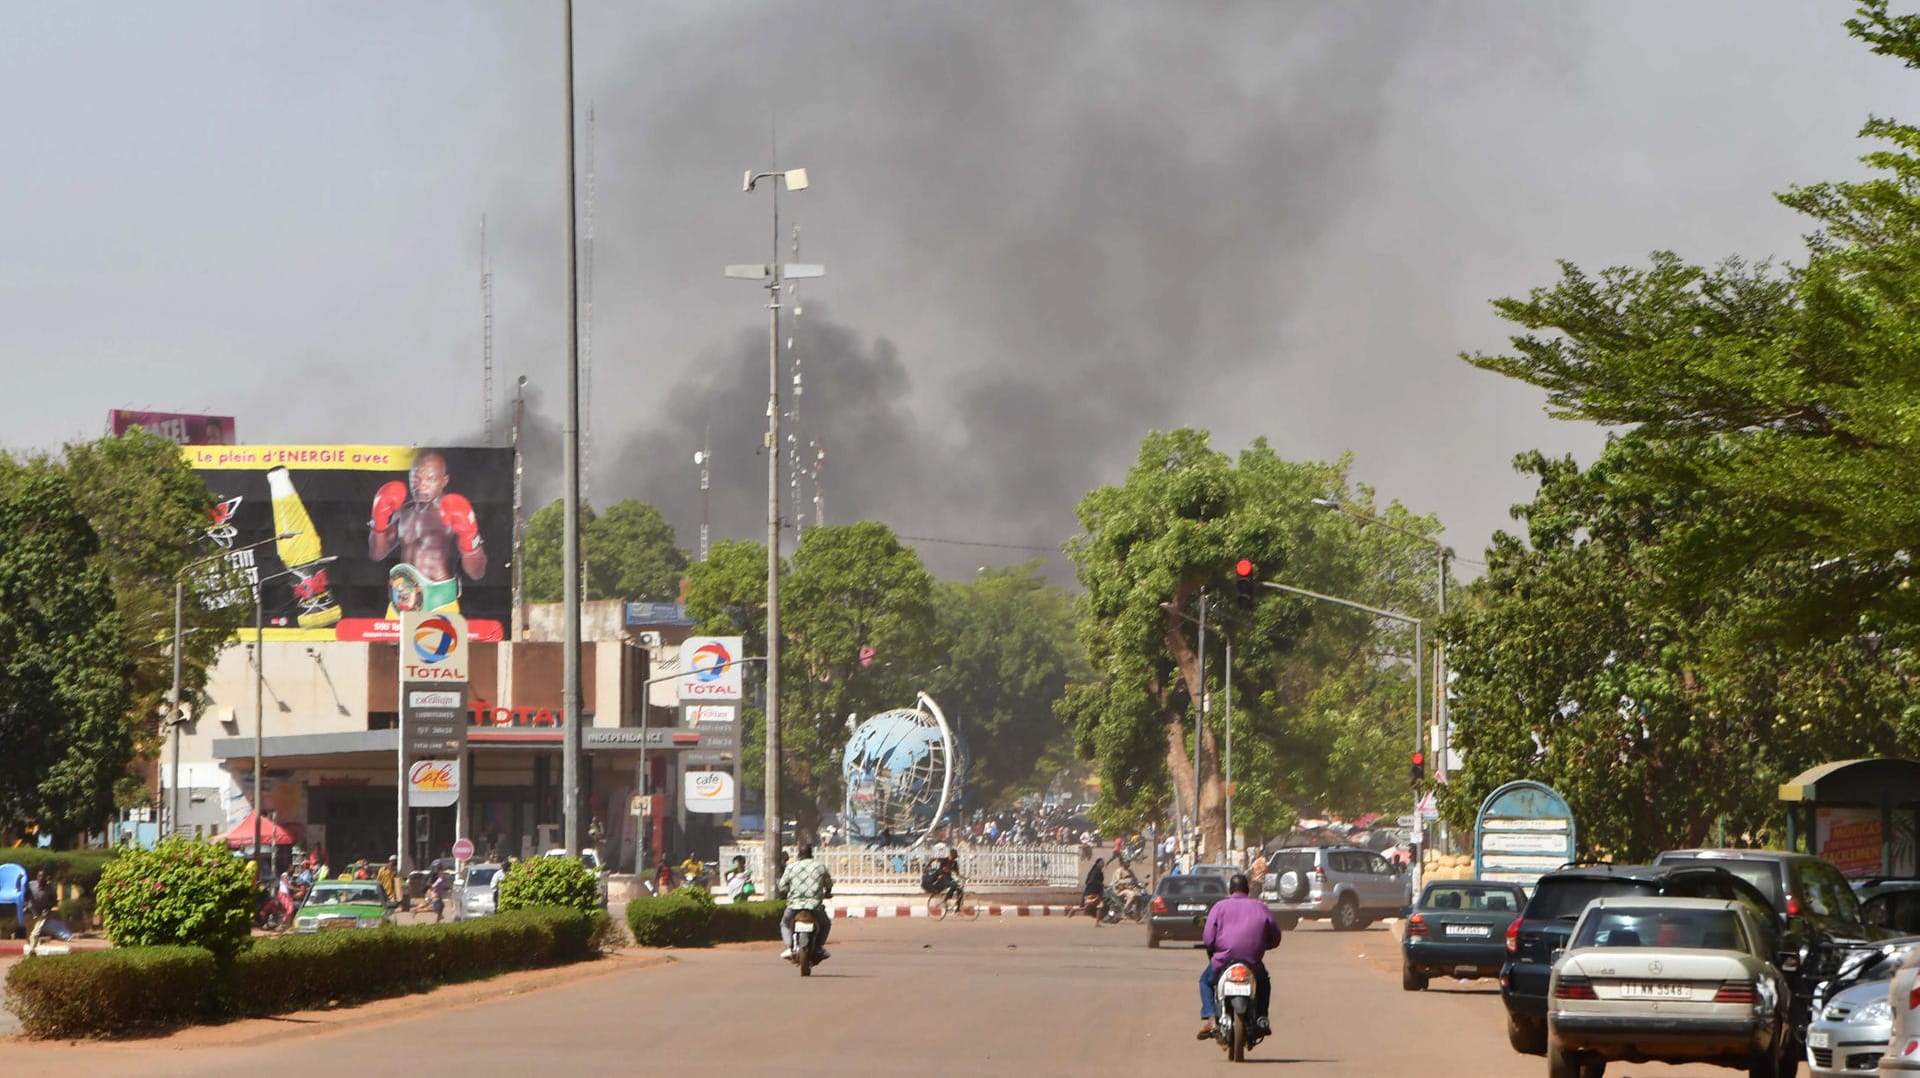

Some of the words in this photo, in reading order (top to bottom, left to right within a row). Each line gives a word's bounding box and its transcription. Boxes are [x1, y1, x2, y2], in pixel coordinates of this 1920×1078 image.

[197, 451, 213, 463] Le
[219, 451, 256, 465] plein
[262, 450, 345, 463] d'ENERGIE
[352, 454, 389, 464] avec
[405, 665, 465, 679] TOTAL
[684, 683, 736, 694] TOTAL
